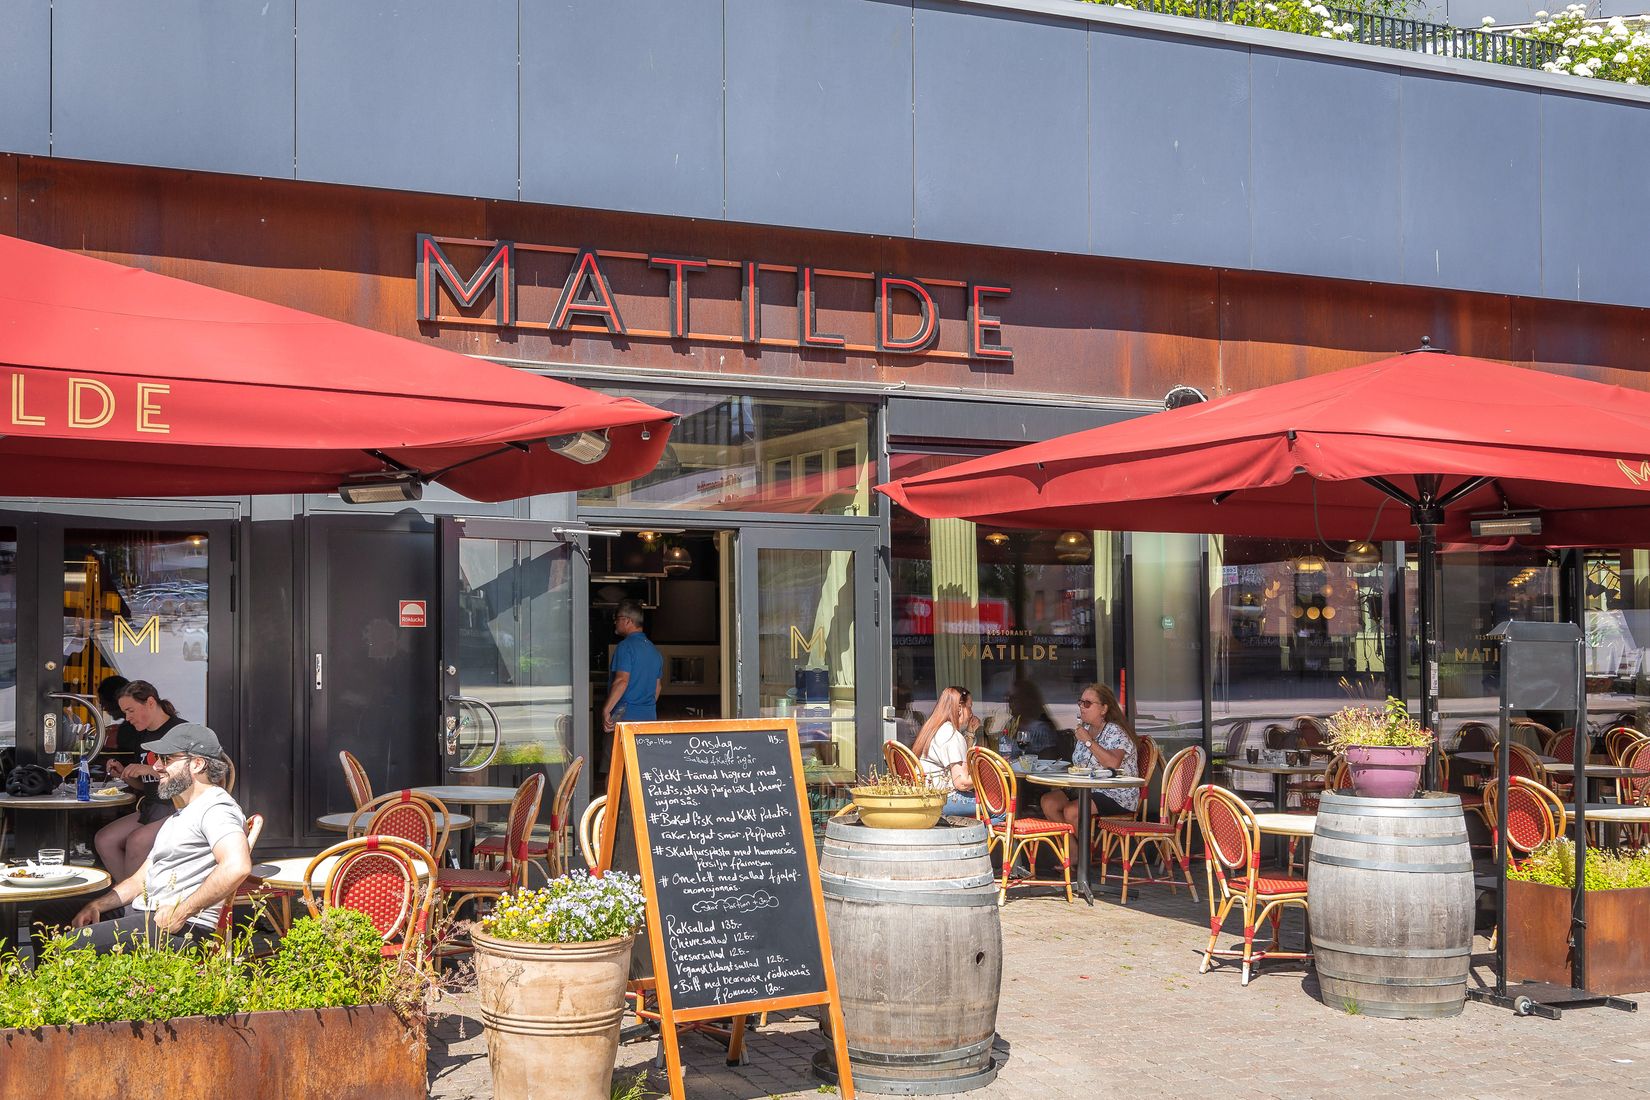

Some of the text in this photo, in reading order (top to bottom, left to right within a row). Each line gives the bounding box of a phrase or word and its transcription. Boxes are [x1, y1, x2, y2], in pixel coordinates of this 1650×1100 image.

[415, 233, 1014, 361] MATILDE
[12, 374, 170, 434] LDE
[114, 615, 159, 654] M
[987, 629, 1033, 637] RISTORANTE
[790, 625, 825, 659] M
[961, 644, 1058, 661] MATILDE
[1455, 647, 1498, 662] MATI
[689, 736, 734, 758] Onsdag
[756, 765, 777, 778] med
[715, 811, 736, 823] med
[733, 845, 752, 857] med
[718, 872, 737, 882] med
[704, 979, 721, 990] med
